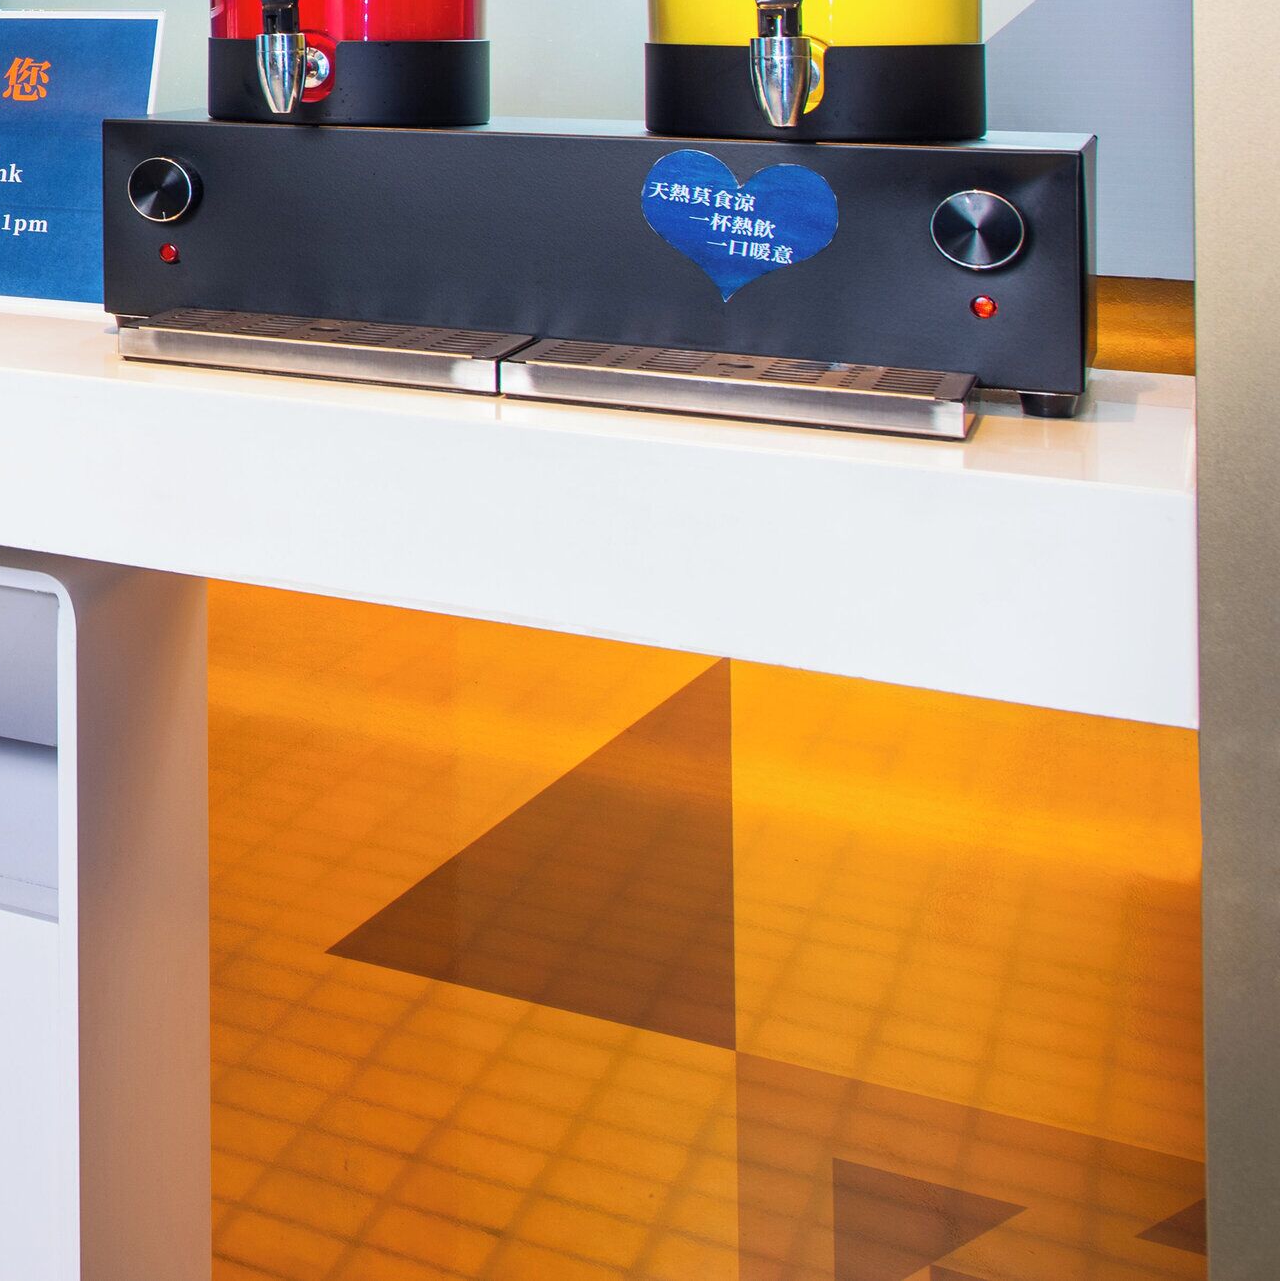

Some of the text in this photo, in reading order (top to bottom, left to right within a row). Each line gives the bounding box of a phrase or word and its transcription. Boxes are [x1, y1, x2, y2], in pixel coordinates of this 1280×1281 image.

[689, 212, 776, 239] 一杯熱飲
[707, 239, 793, 264] 一口暖意
